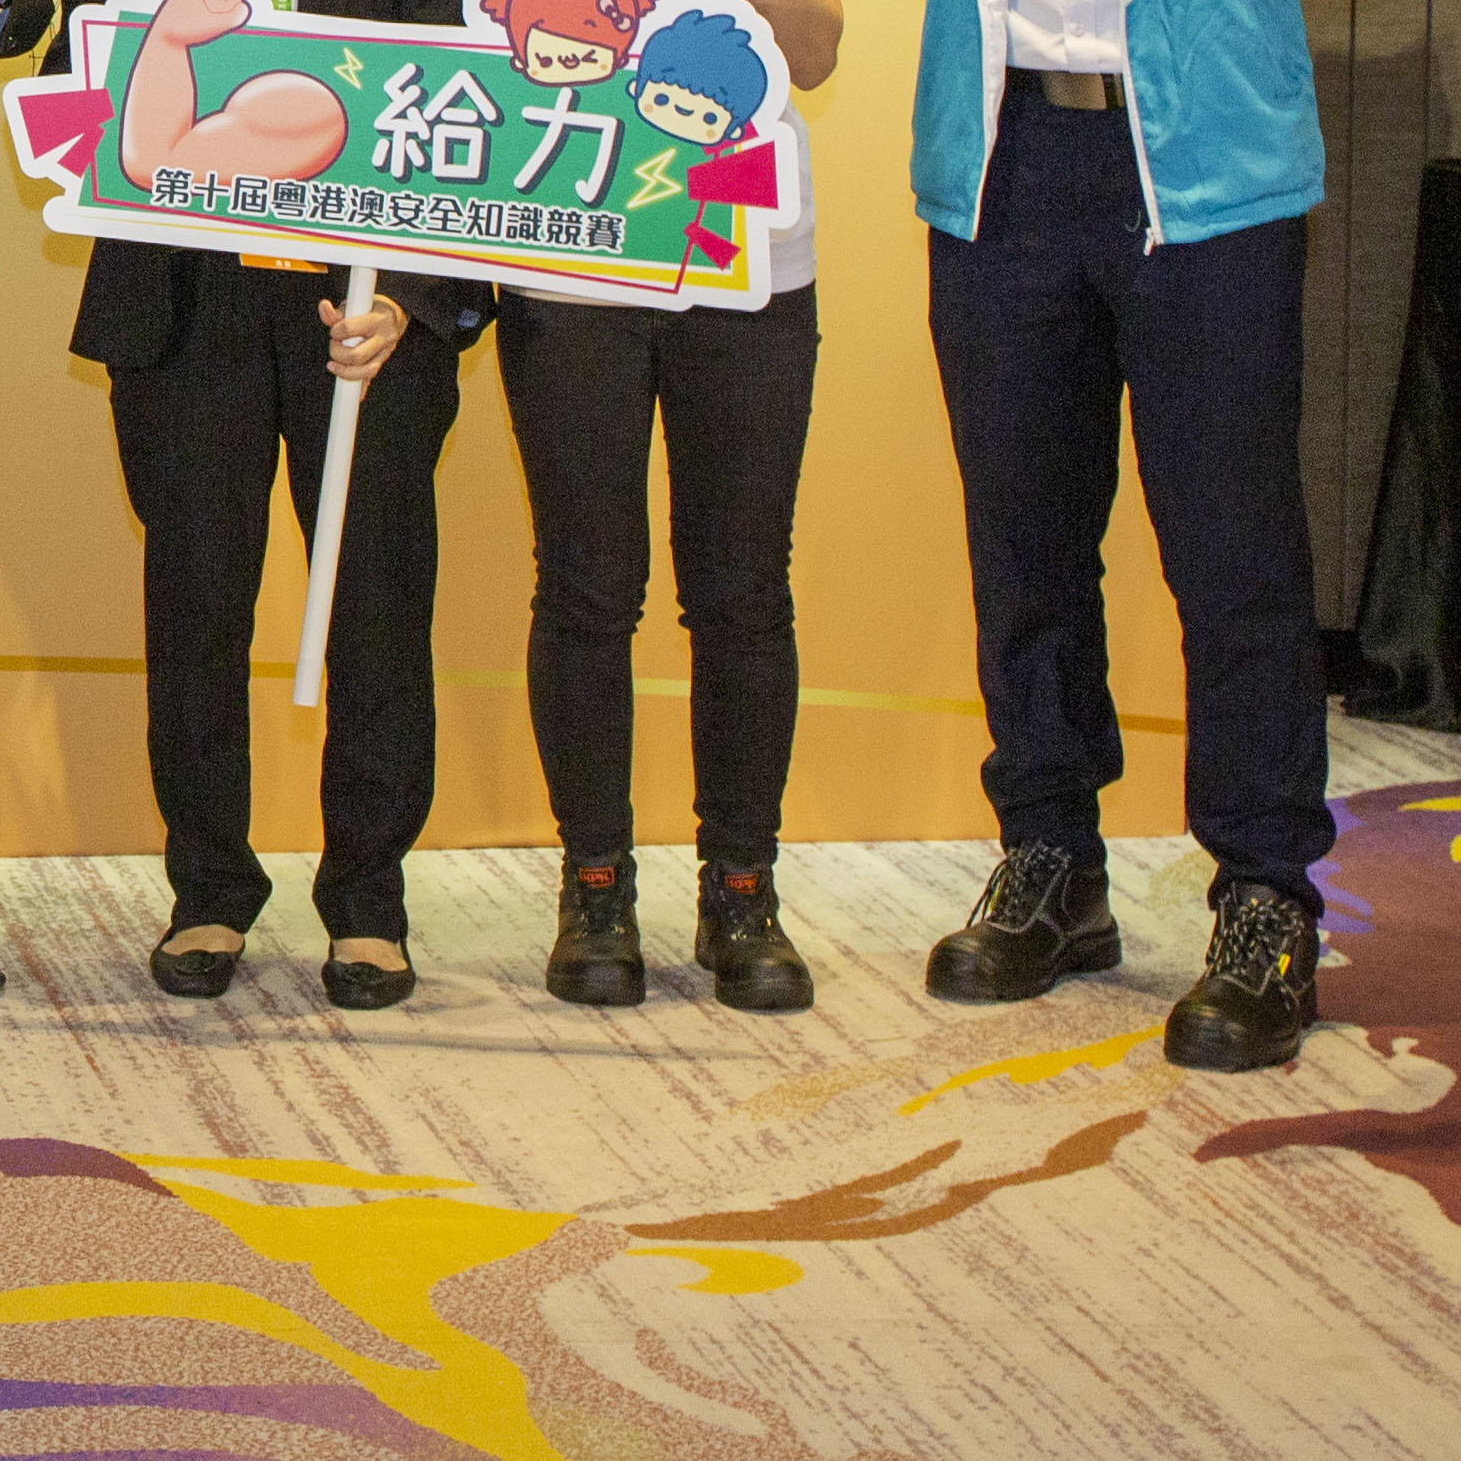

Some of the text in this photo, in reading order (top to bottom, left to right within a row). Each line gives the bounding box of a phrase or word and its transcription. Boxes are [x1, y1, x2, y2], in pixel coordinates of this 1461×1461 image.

[370, 62, 620, 204] 給力
[150, 167, 625, 252] 第十屆粵港澳安全知識競賽
